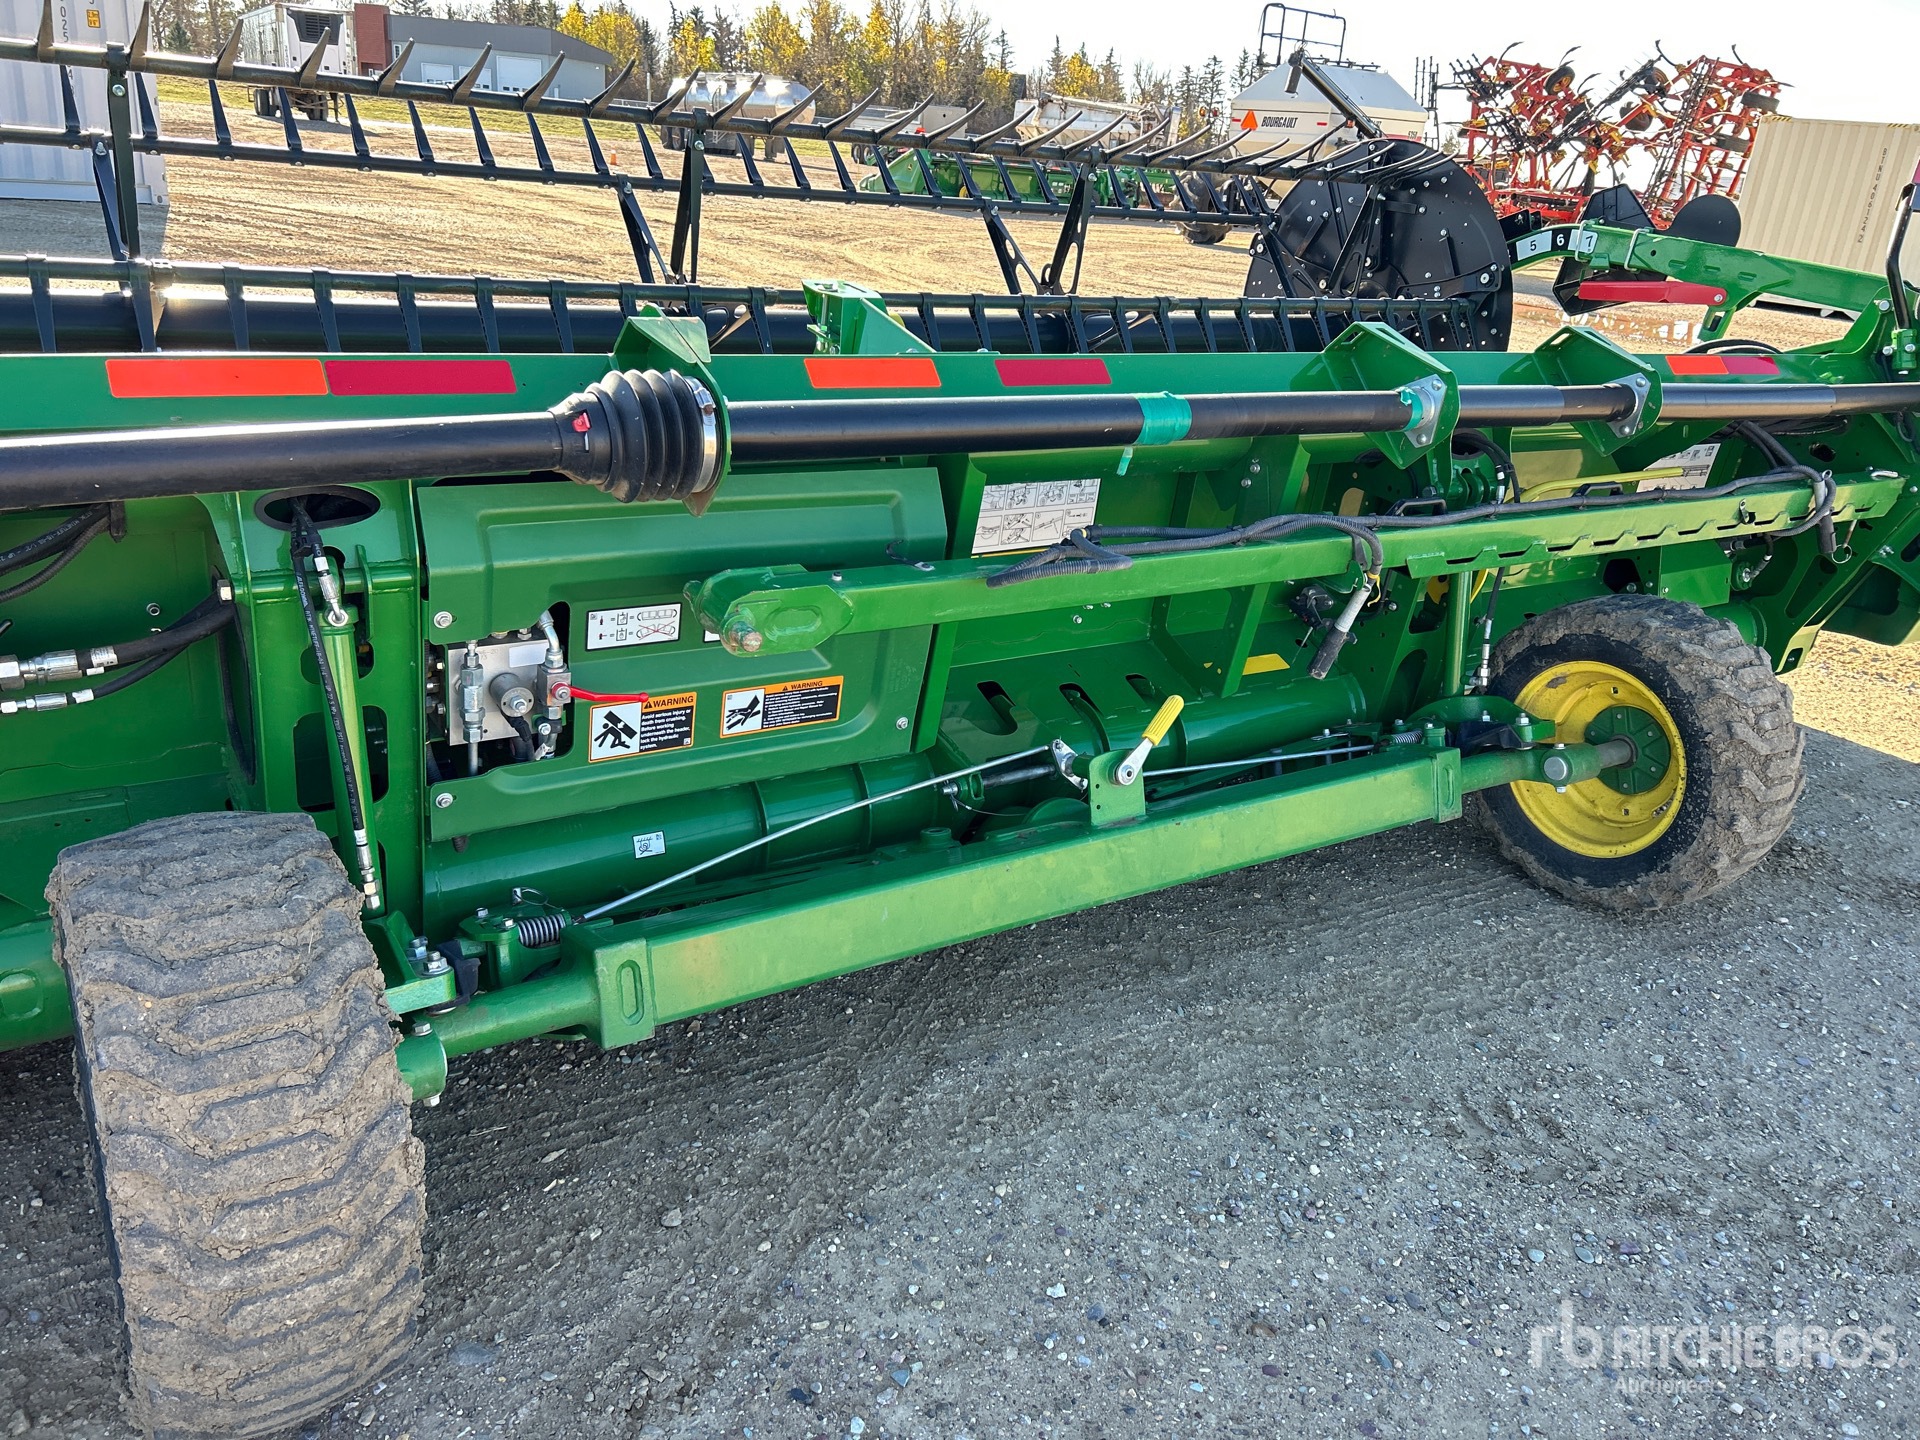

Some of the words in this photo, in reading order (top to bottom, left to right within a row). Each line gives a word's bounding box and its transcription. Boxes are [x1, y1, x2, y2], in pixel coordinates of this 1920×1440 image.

[1261, 116, 1298, 128] BOURGAULT
[1530, 240, 1537, 251] 5
[1556, 233, 1565, 246] 6
[1585, 235, 1594, 248] 7
[791, 681, 823, 690] WARNING
[653, 696, 694, 707] WARNING
